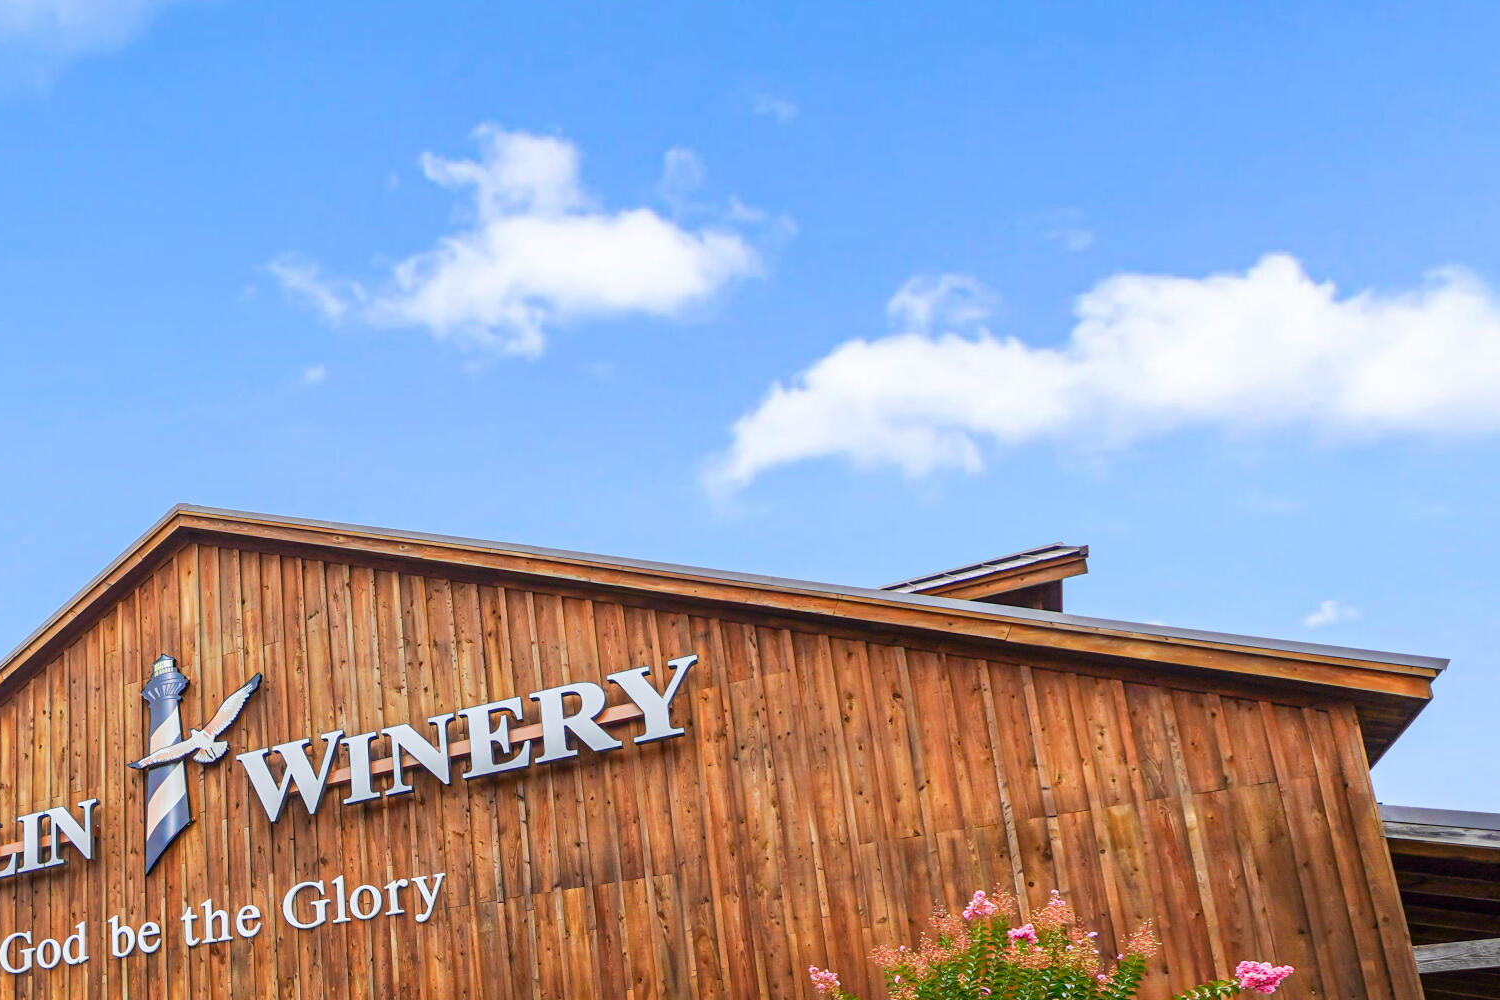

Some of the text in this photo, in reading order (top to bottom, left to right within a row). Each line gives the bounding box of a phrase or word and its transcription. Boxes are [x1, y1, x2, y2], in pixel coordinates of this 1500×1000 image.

[236, 655, 699, 823] WINERY
[0, 873, 446, 975] God be the Glory
